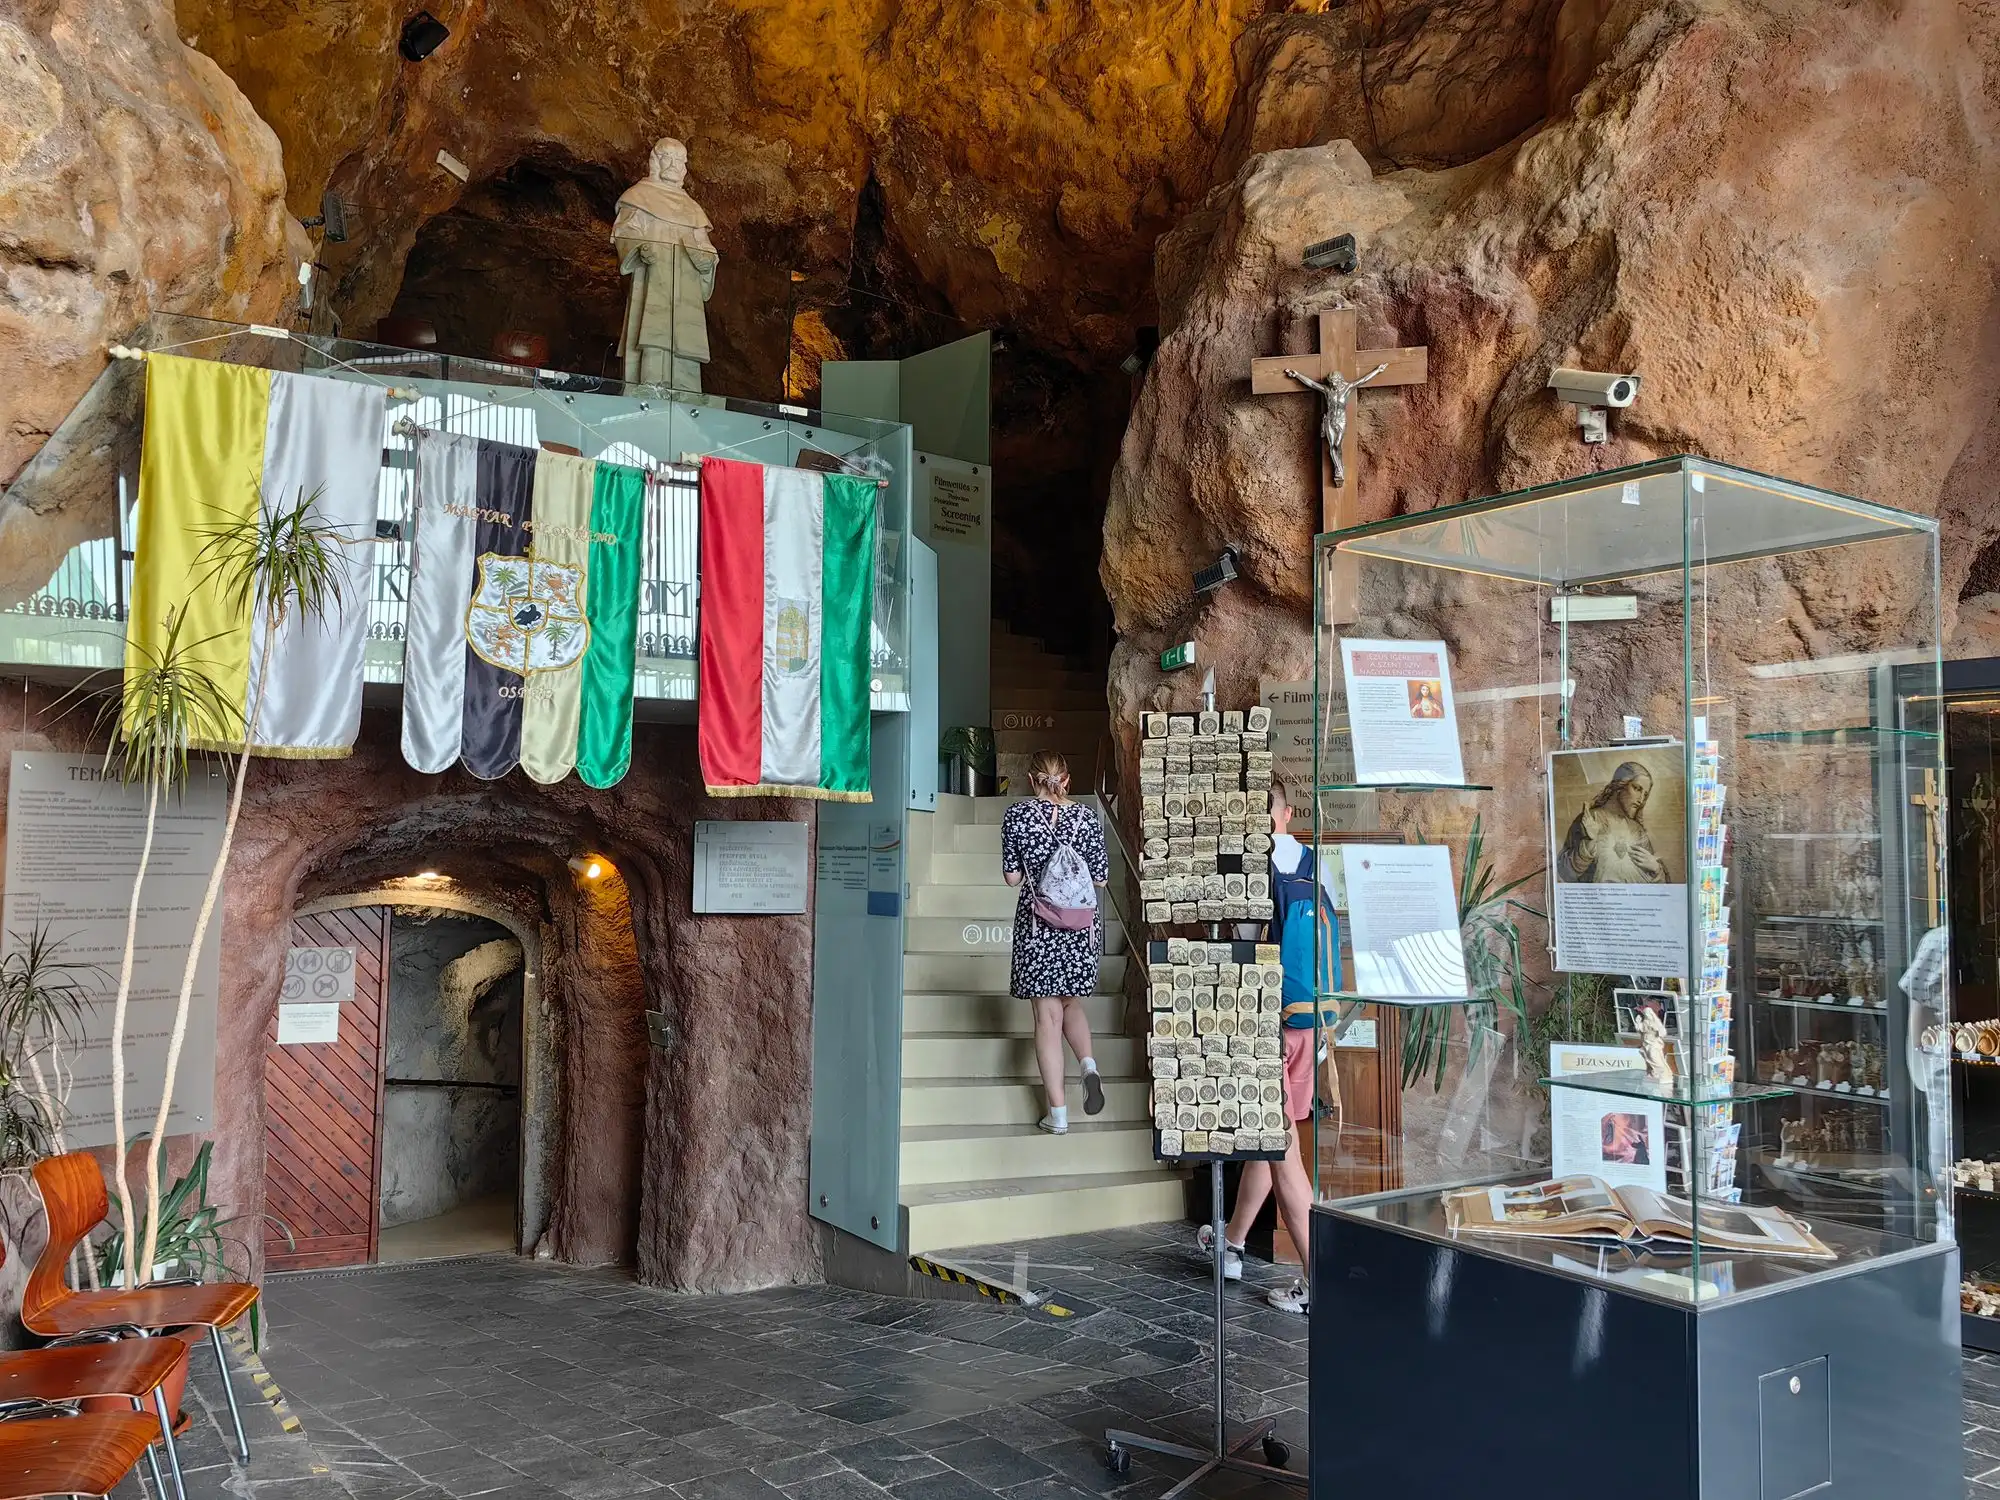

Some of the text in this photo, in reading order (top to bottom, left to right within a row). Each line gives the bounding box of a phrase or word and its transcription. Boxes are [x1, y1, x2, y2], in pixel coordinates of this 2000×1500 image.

[443, 503, 513, 528] MAGYAR
[941, 507, 981, 526] Screening
[1020, 715, 1042, 727] 104
[984, 926, 1013, 943] 103
